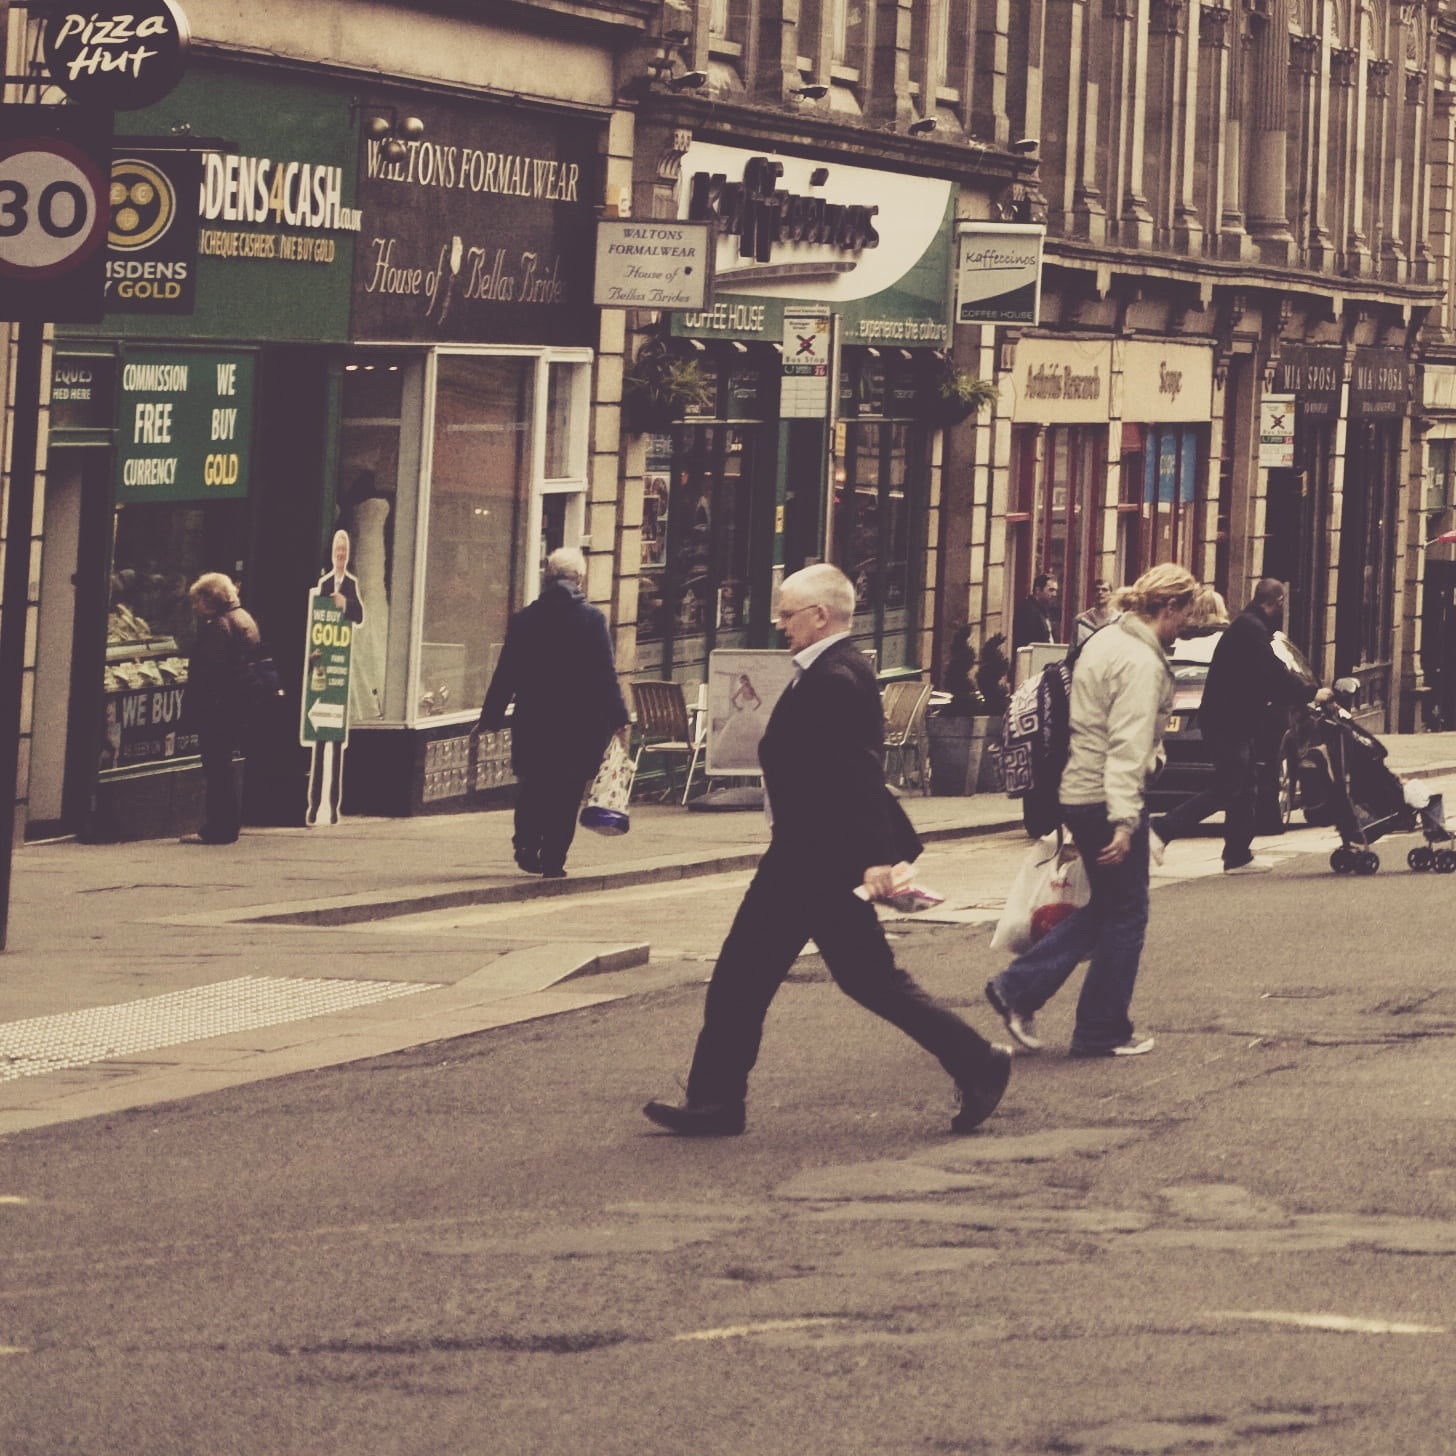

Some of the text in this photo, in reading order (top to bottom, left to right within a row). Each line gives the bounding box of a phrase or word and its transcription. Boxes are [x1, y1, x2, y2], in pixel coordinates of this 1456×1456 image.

[54, 13, 168, 49] Pizza
[67, 45, 158, 81] Hut
[459, 149, 579, 202] FORMALWEAR
[0, 180, 88, 238] 30
[205, 231, 239, 258] CHEQUE
[239, 233, 275, 258] CASHERS
[297, 236, 314, 261] BUY
[314, 238, 336, 263] GOLD
[623, 228, 683, 240] WALTONS
[608, 244, 697, 257] FORMALWEAR
[966, 249, 1036, 268] Kaffeccinos
[365, 238, 421, 295] House
[425, 243, 448, 317] of
[464, 246, 514, 303] Bellas
[624, 264, 680, 283] House of
[117, 280, 181, 299] GOLD
[728, 304, 766, 331] HOUSE
[961, 310, 1033, 320] COFFEE HOUSE
[123, 363, 188, 392] COMMISSION
[217, 363, 237, 396] WE
[1307, 366, 1336, 391] SPOSA
[1378, 367, 1403, 391] SPOSA
[133, 402, 173, 444] FREE
[211, 408, 238, 441] BUY
[123, 457, 178, 487] CURRENCY
[204, 453, 239, 486] GOLD
[312, 623, 351, 647] GOLD
